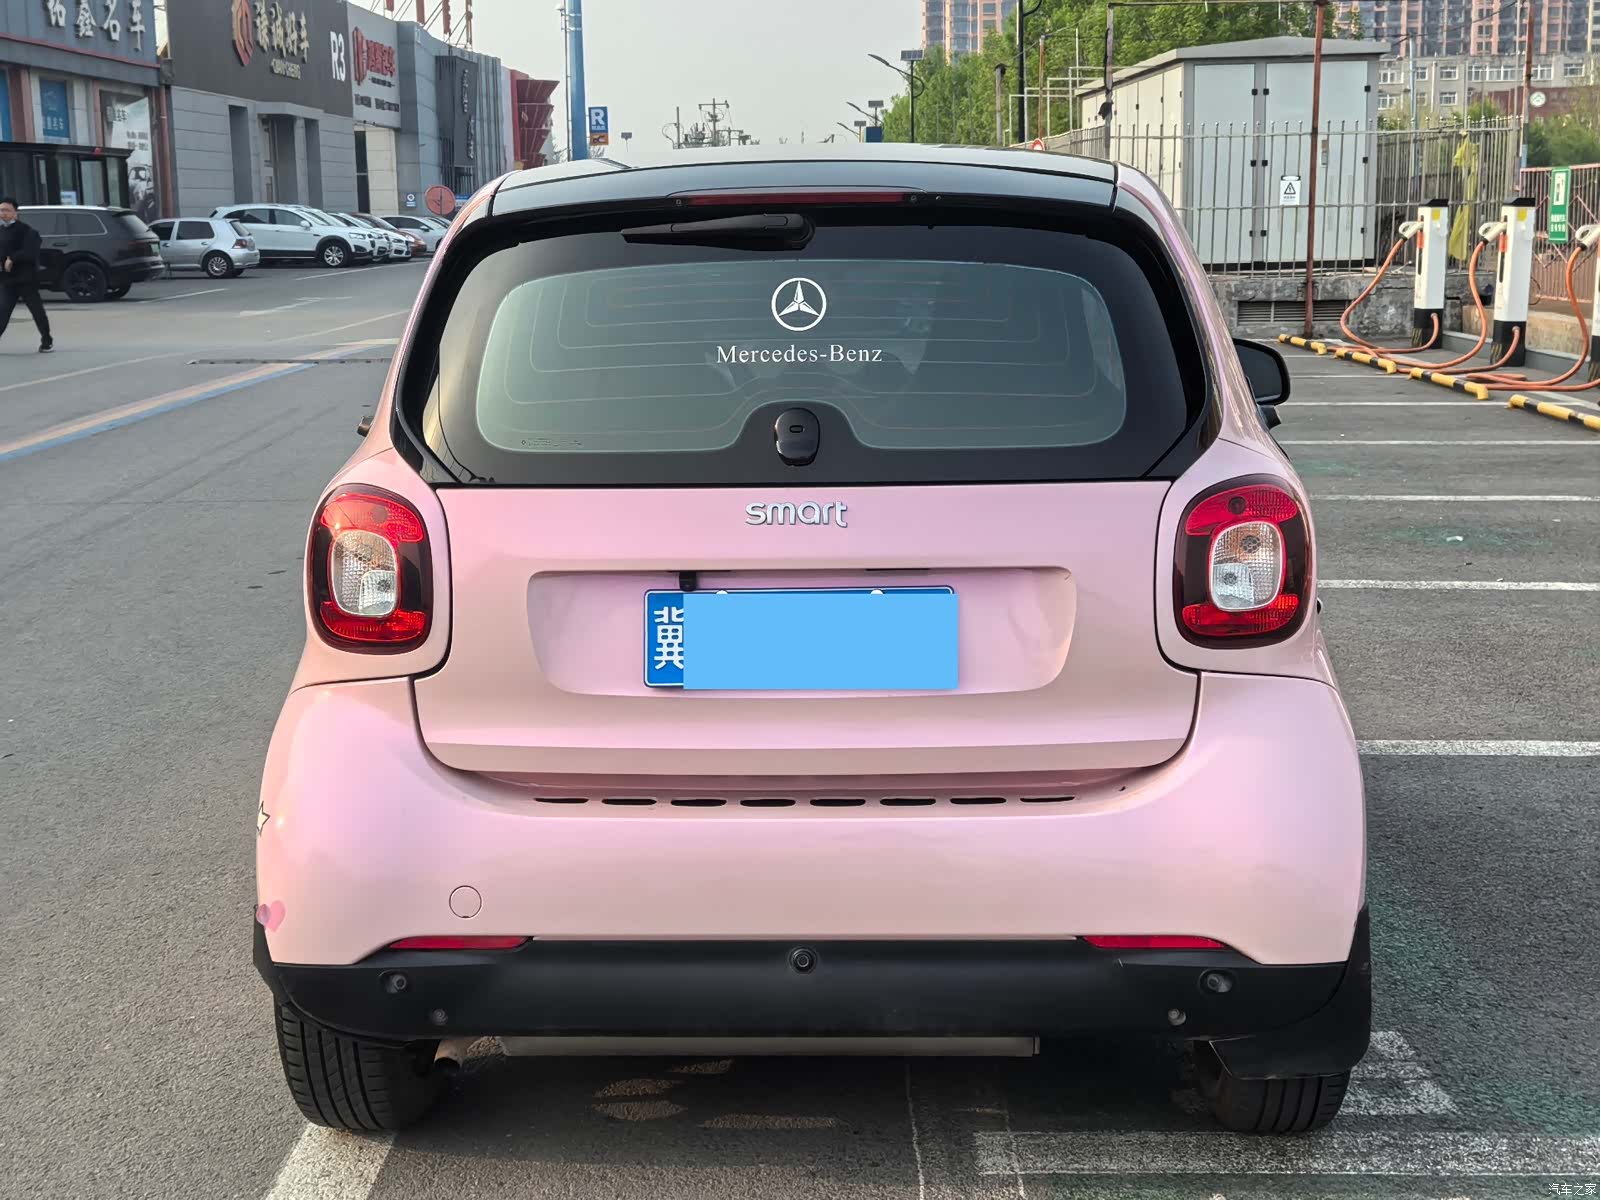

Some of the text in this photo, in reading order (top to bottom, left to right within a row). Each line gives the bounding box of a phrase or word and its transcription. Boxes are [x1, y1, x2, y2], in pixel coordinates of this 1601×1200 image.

[330, 31, 346, 82] R3
[716, 344, 883, 364] Mercedes-Benz
[745, 500, 848, 529] smart
[653, 606, 685, 670] 冀
